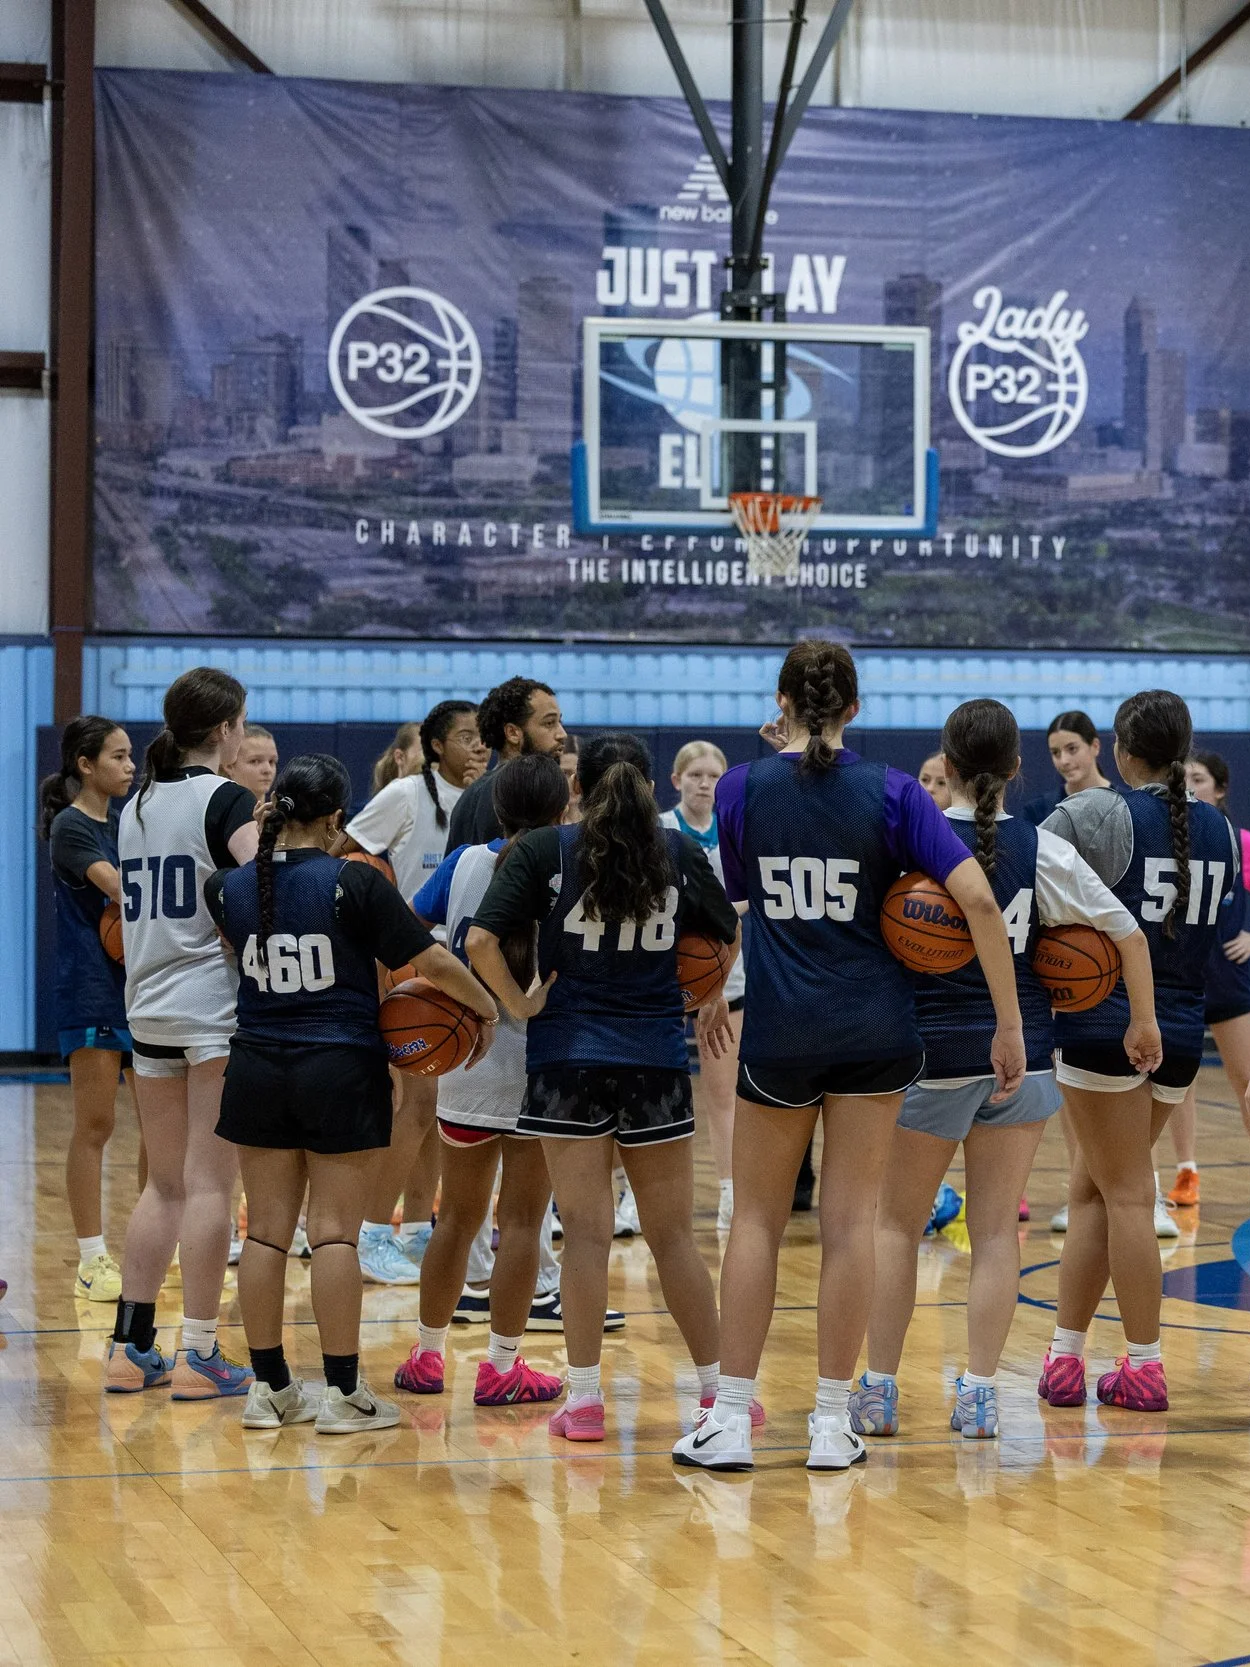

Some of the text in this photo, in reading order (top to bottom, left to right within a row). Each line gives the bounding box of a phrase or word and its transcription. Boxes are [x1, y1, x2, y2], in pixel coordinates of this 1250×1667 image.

[659, 204, 779, 225] new bale
[596, 245, 718, 310] JUST
[957, 285, 1090, 353] Lady
[347, 340, 431, 384] P32
[966, 363, 1042, 404] P32
[355, 518, 571, 550] CHARACTER
[566, 556, 611, 584] THE
[120, 854, 197, 923] 510
[757, 855, 860, 922] 505
[1140, 856, 1226, 926] 511
[241, 933, 336, 994] 460
